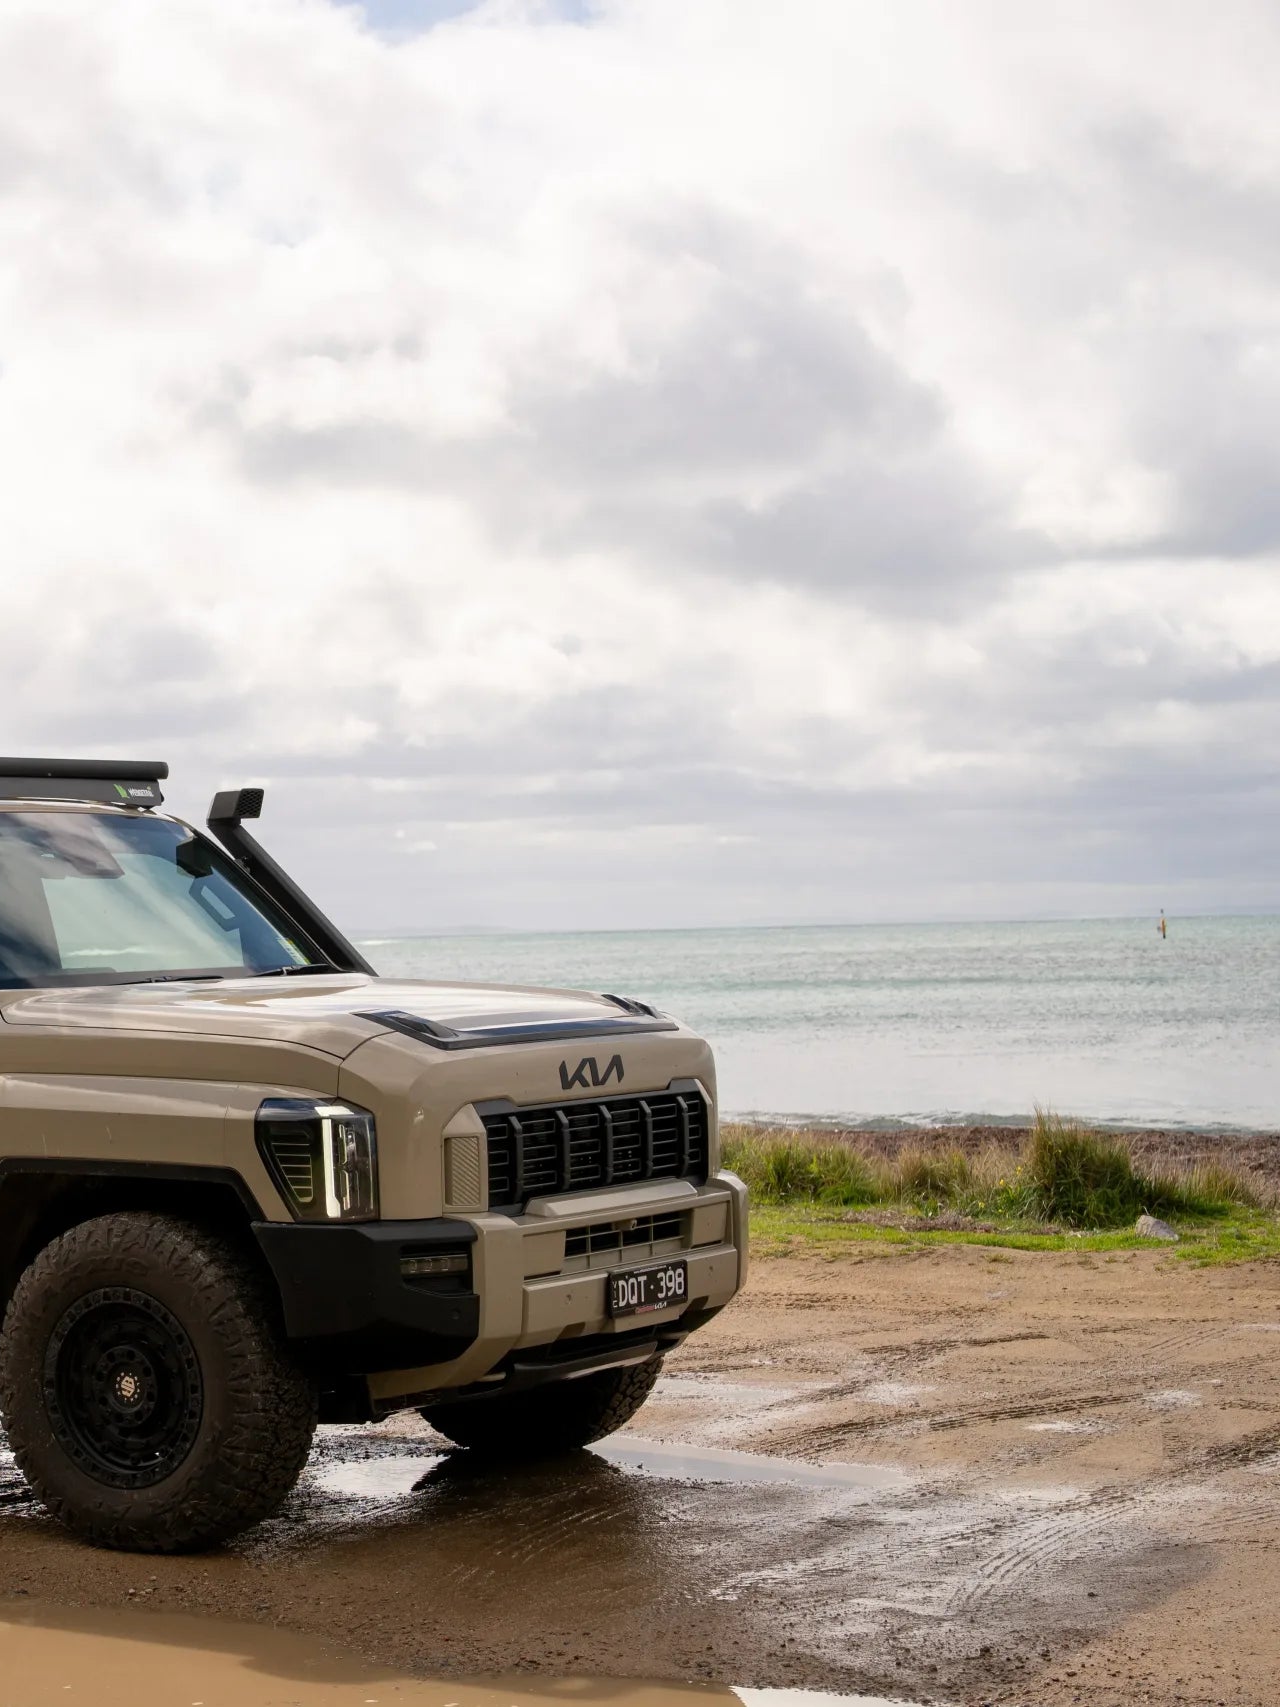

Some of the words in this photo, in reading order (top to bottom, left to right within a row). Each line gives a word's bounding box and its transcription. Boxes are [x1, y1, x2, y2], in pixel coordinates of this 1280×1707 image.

[558, 1054, 625, 1090] KIA
[618, 1275, 647, 1307] DQT
[657, 1268, 685, 1299] 398
